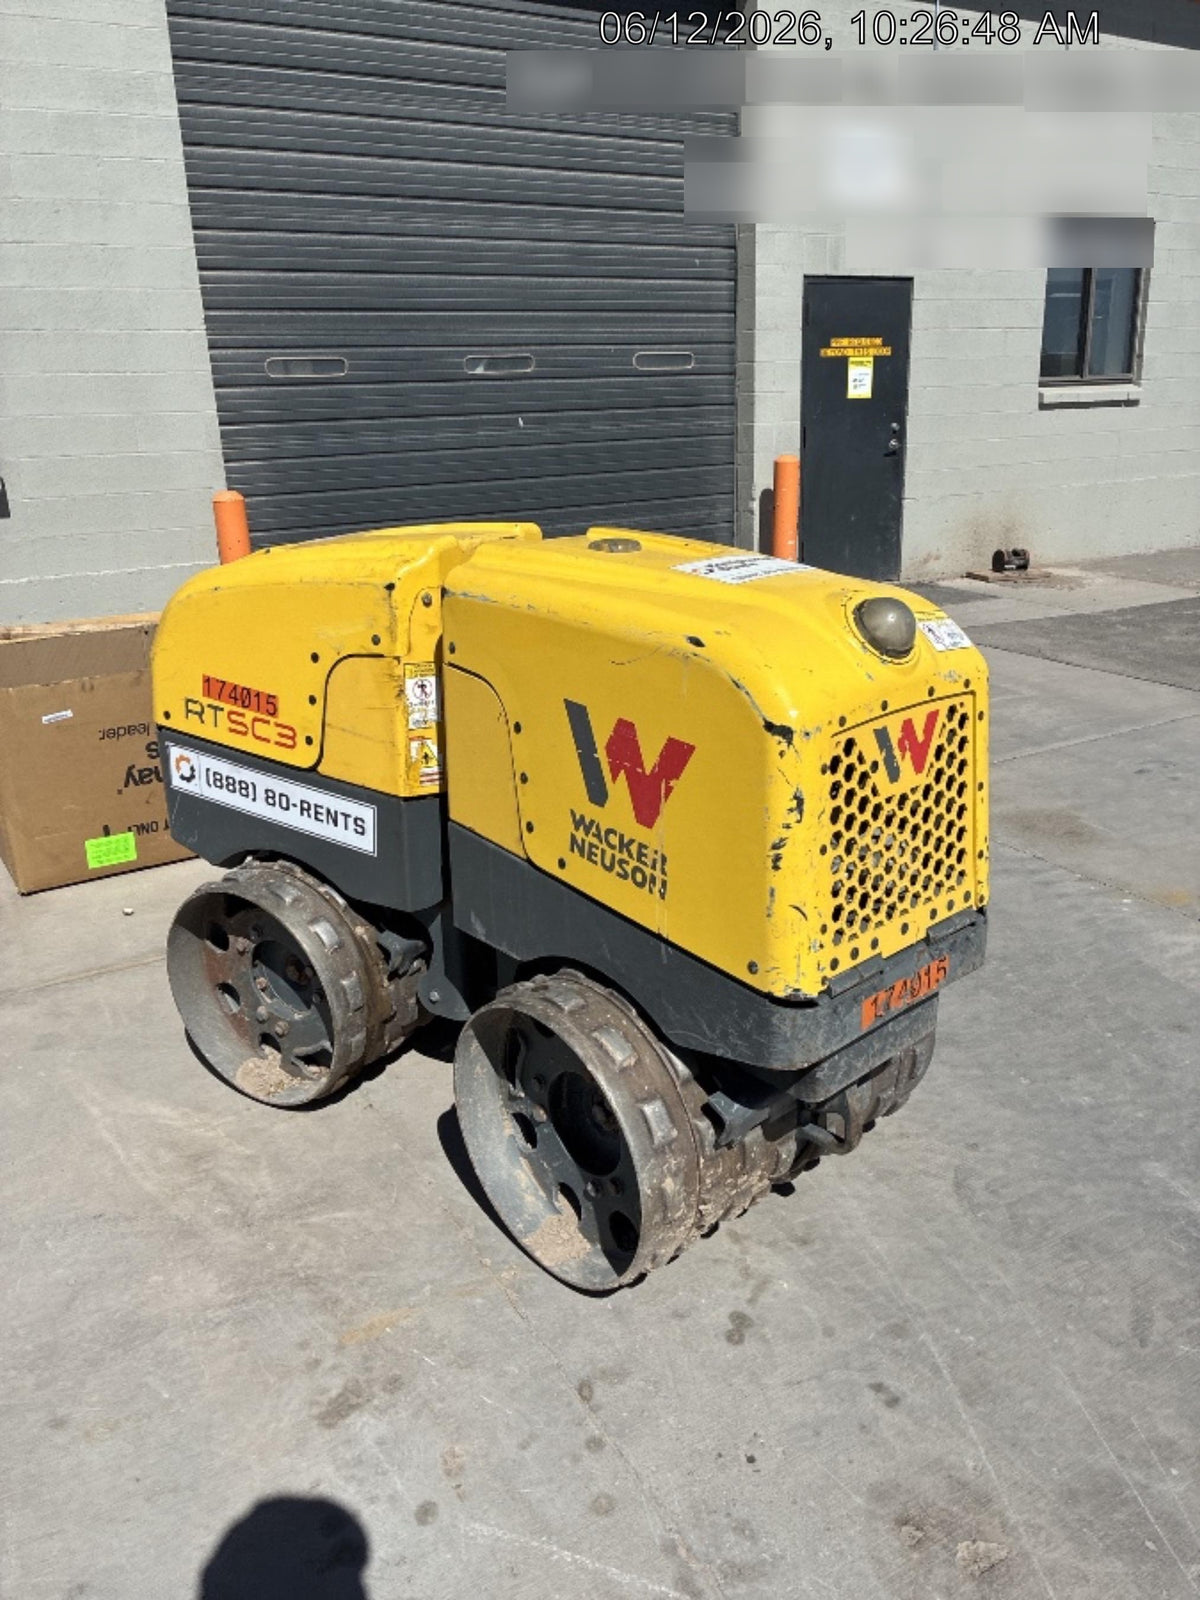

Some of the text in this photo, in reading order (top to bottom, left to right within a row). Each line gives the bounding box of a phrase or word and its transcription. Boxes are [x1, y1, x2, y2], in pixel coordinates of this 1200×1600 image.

[185, 697, 298, 750] RTSC3
[203, 676, 278, 716] 174015
[98, 722, 150, 740] leader.
[204, 766, 367, 837] (888) 80-RENTS
[568, 831, 668, 901] NEUSON
[569, 808, 668, 877] WACKER
